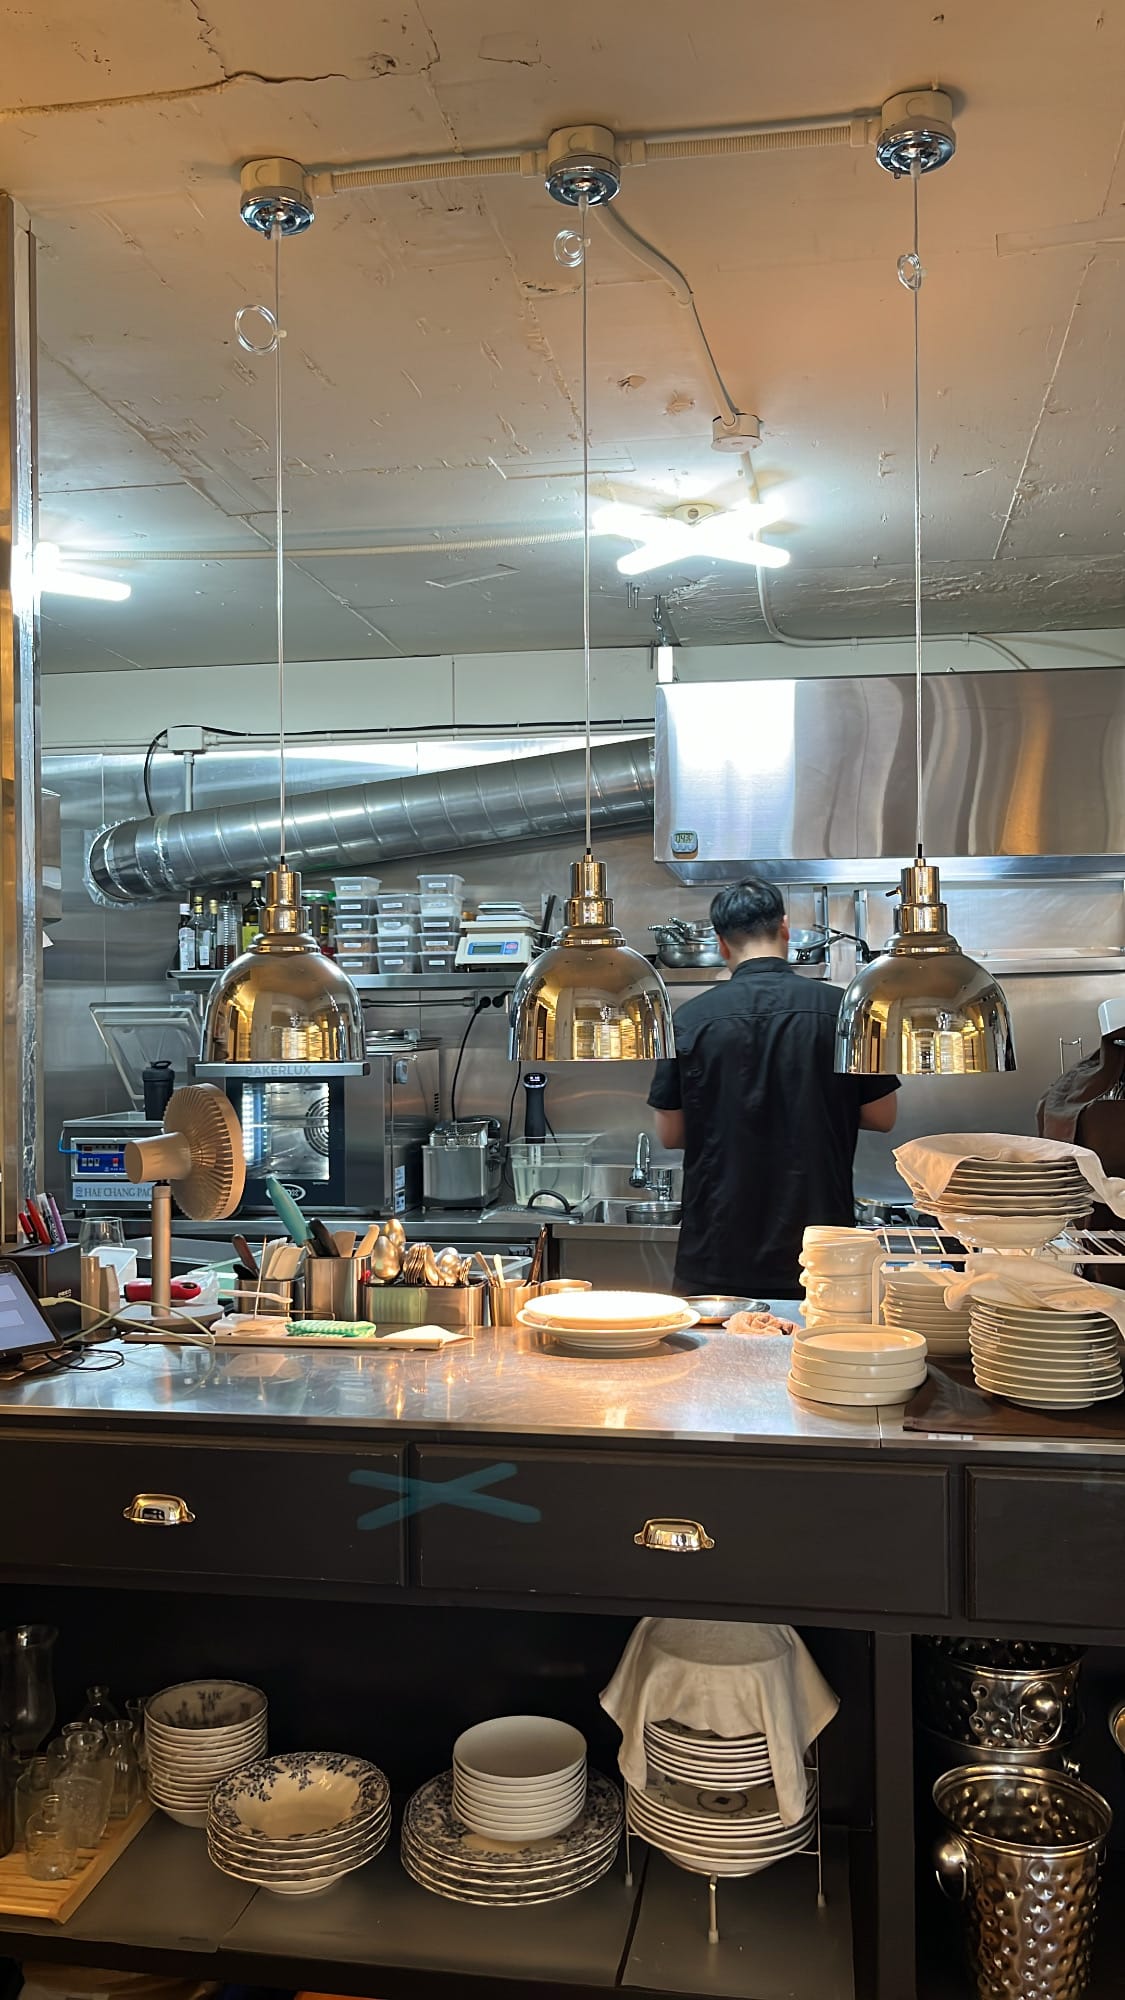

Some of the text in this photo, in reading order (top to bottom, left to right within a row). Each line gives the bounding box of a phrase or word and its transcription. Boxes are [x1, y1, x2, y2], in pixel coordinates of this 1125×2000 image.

[246, 1065, 311, 1075] BAKERLUX
[84, 1187, 102, 1197] HAE
[103, 1187, 136, 1198] CHANG
